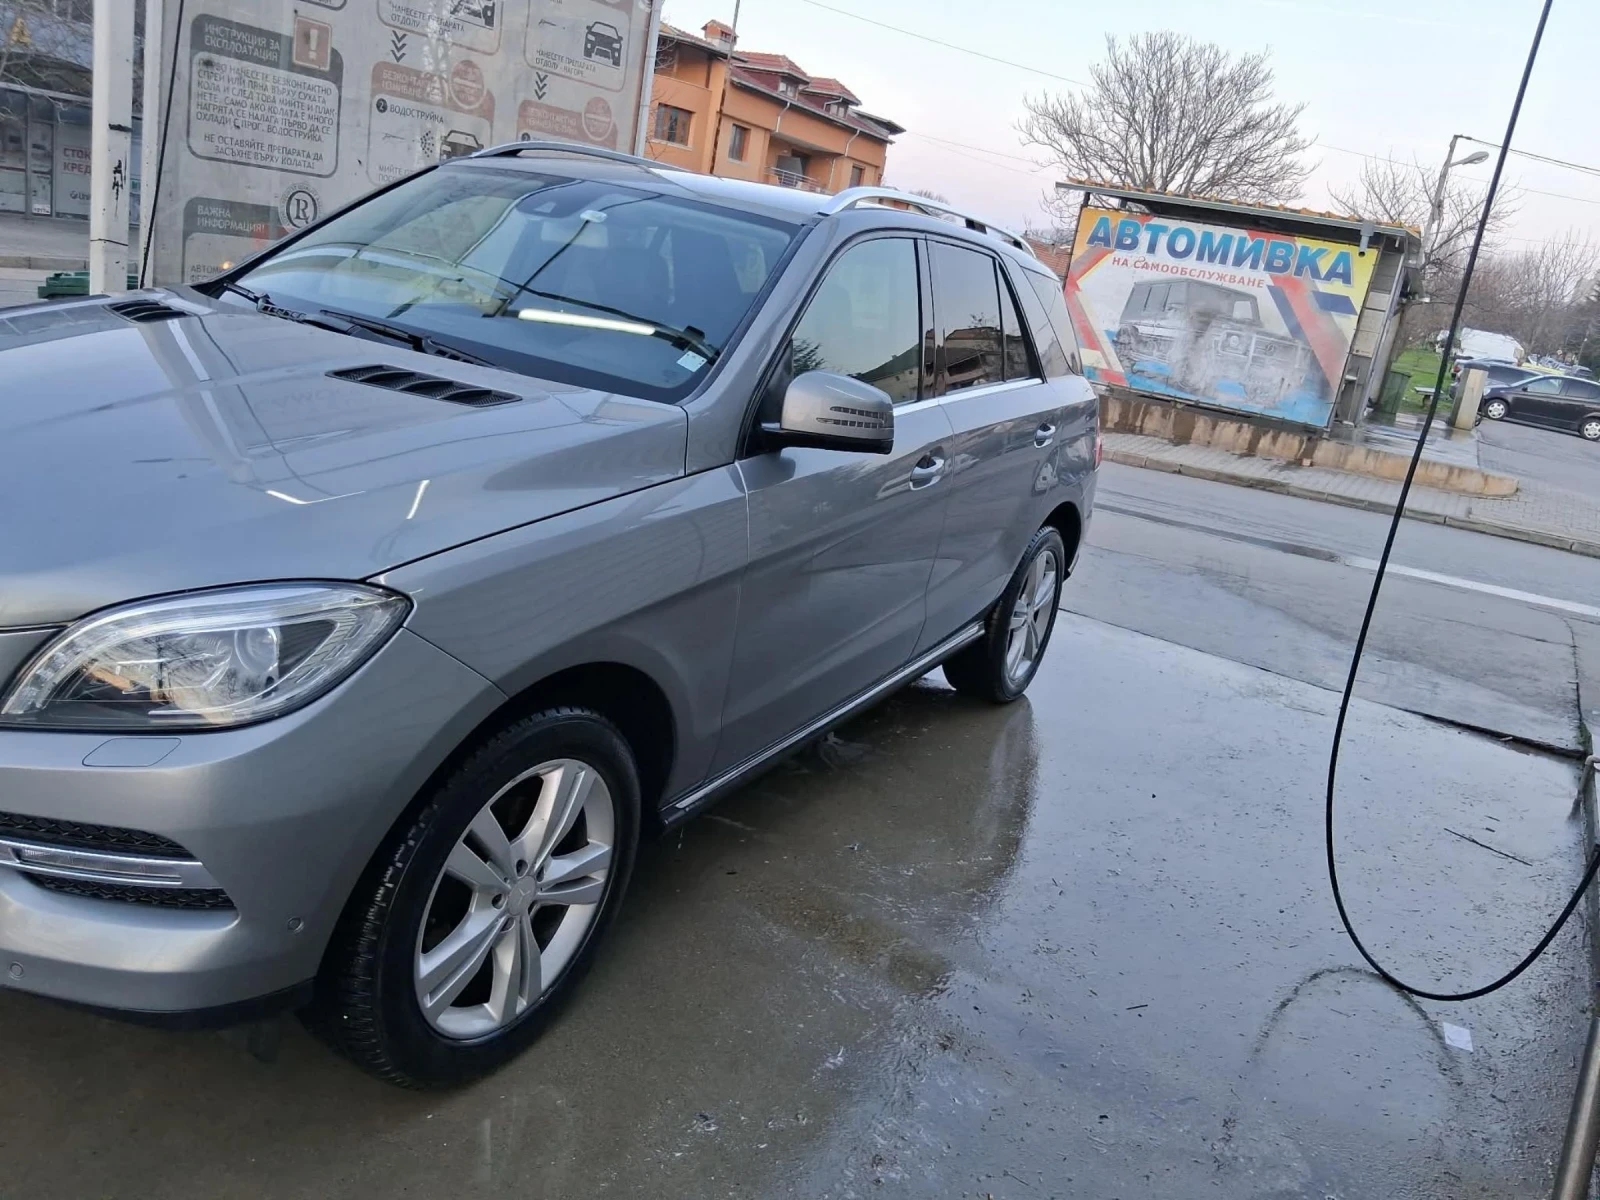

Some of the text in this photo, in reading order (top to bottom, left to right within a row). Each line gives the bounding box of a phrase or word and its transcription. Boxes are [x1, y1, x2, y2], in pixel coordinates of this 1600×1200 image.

[391, 13, 421, 28] ОТДОЛУ
[204, 22, 280, 51] ИНСТРУКЦИЯ ЗА
[204, 35, 279, 62] ЕКСПЛОАТАЦИЯ
[227, 75, 246, 87] ИЛИ
[271, 84, 297, 98] ВЪРХУ
[298, 91, 327, 105] СУХАТА
[229, 64, 269, 82] НАНЕСЕТЕ
[272, 75, 332, 96] БЕЗКОНТАКТНО
[197, 80, 220, 93] КОЛА
[223, 85, 229, 93] И
[231, 87, 253, 100] СЛЕД
[256, 92, 276, 104] ТОВА
[307, 103, 313, 112] И
[196, 101, 331, 135] НАГРЯТА СЕ НАЛАГА ПЪРВО ДА СЕ
[196, 111, 231, 125] ОХЛАДИ
[224, 96, 248, 108] САМО
[249, 102, 266, 113] АКО
[267, 105, 299, 119] КОЛАТА
[301, 112, 306, 121] Е
[308, 114, 334, 126] МНОГО
[389, 104, 444, 124] ВОДОСТРУЙКА
[204, 133, 324, 162] НЕ ОСТАВЯЙТЕ ПРЕПАРАТА ДА
[215, 145, 253, 160] ЗАСЪХНЕ
[253, 152, 280, 163] ВЪРХУ
[197, 205, 231, 218] ВАЖНА
[197, 219, 266, 233] ИНФОРМАЦИЯ!
[1086, 216, 1353, 286] АВТОМИВКА
[1112, 257, 1266, 289] НА САМООБСЛУЖВАНЕ
